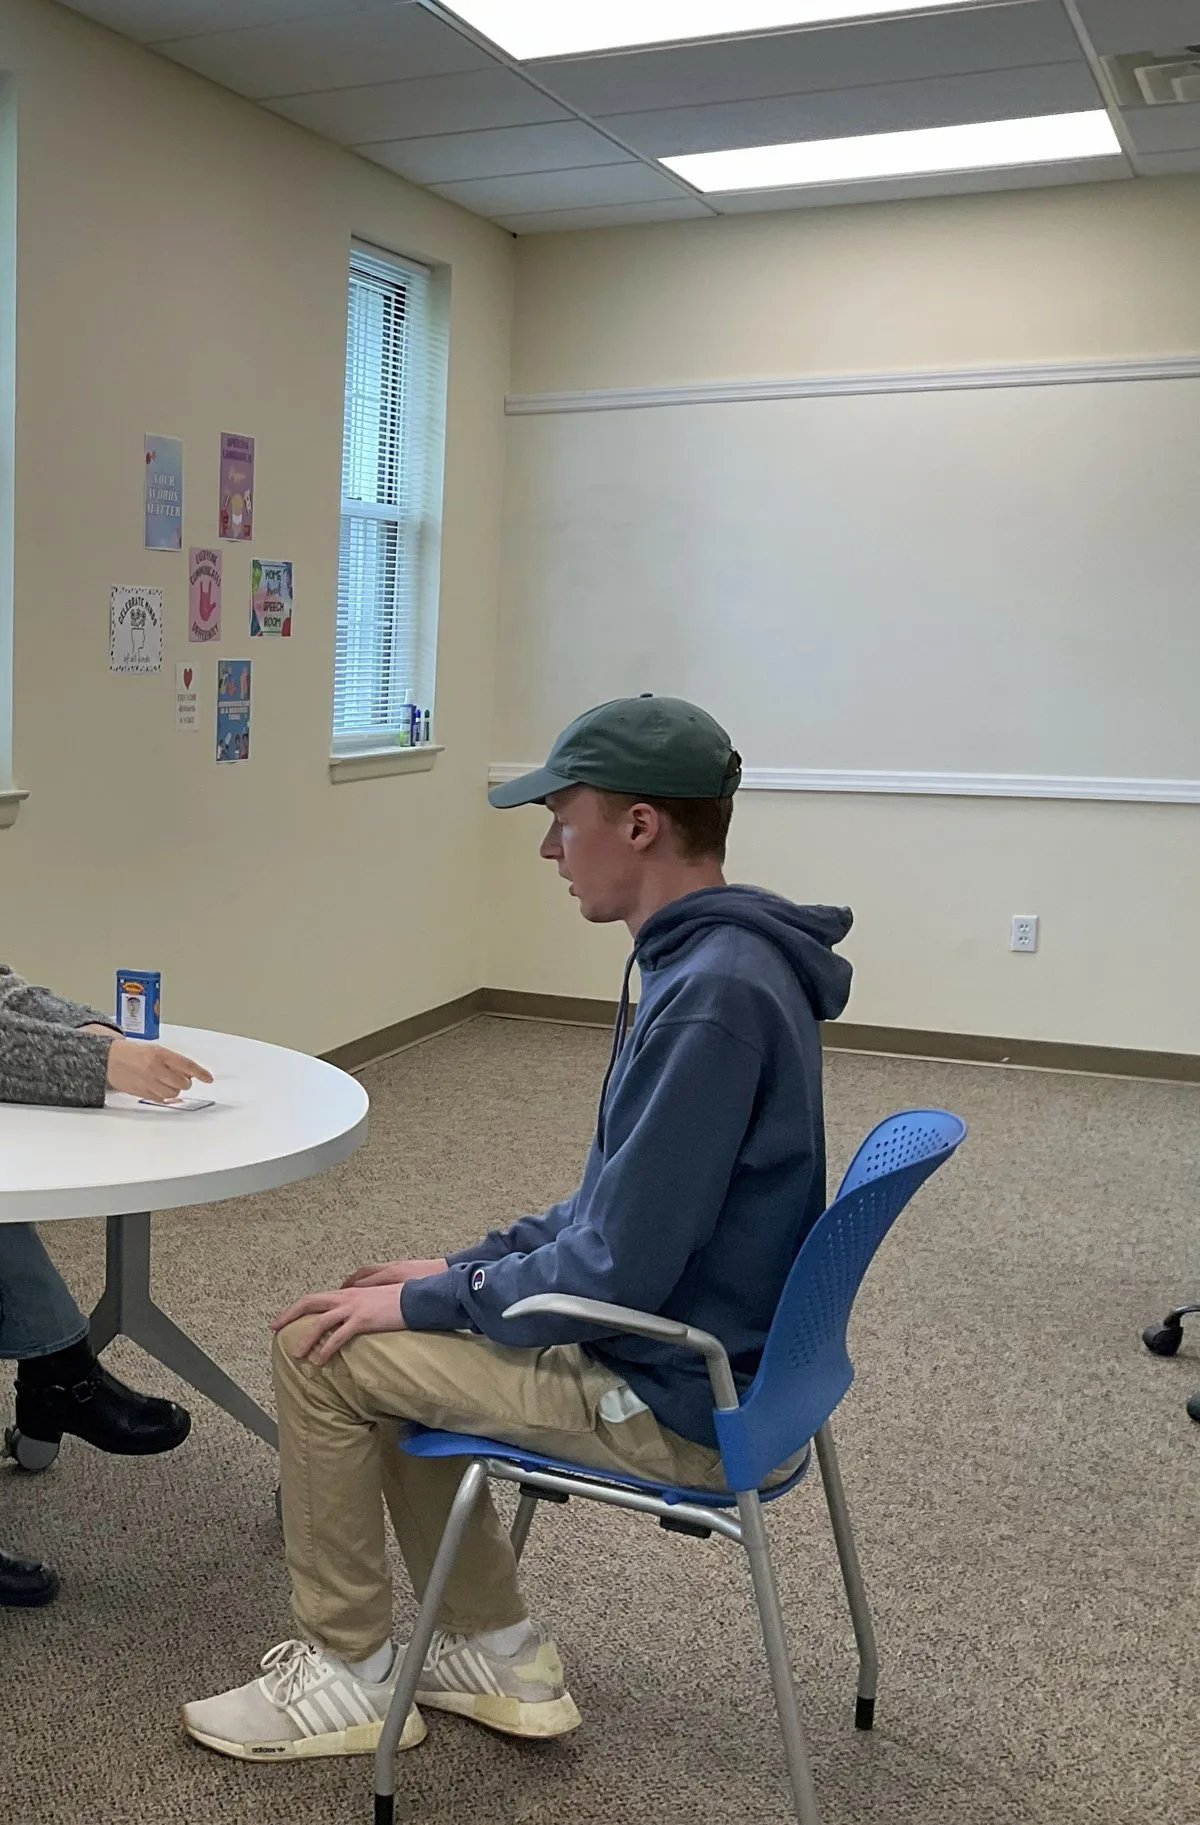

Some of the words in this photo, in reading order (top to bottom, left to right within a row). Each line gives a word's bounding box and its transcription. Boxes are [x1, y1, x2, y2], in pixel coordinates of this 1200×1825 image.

[265, 570, 282, 581] HOME
[264, 602, 284, 612] SPEECH
[264, 616, 282, 627] ROOM
